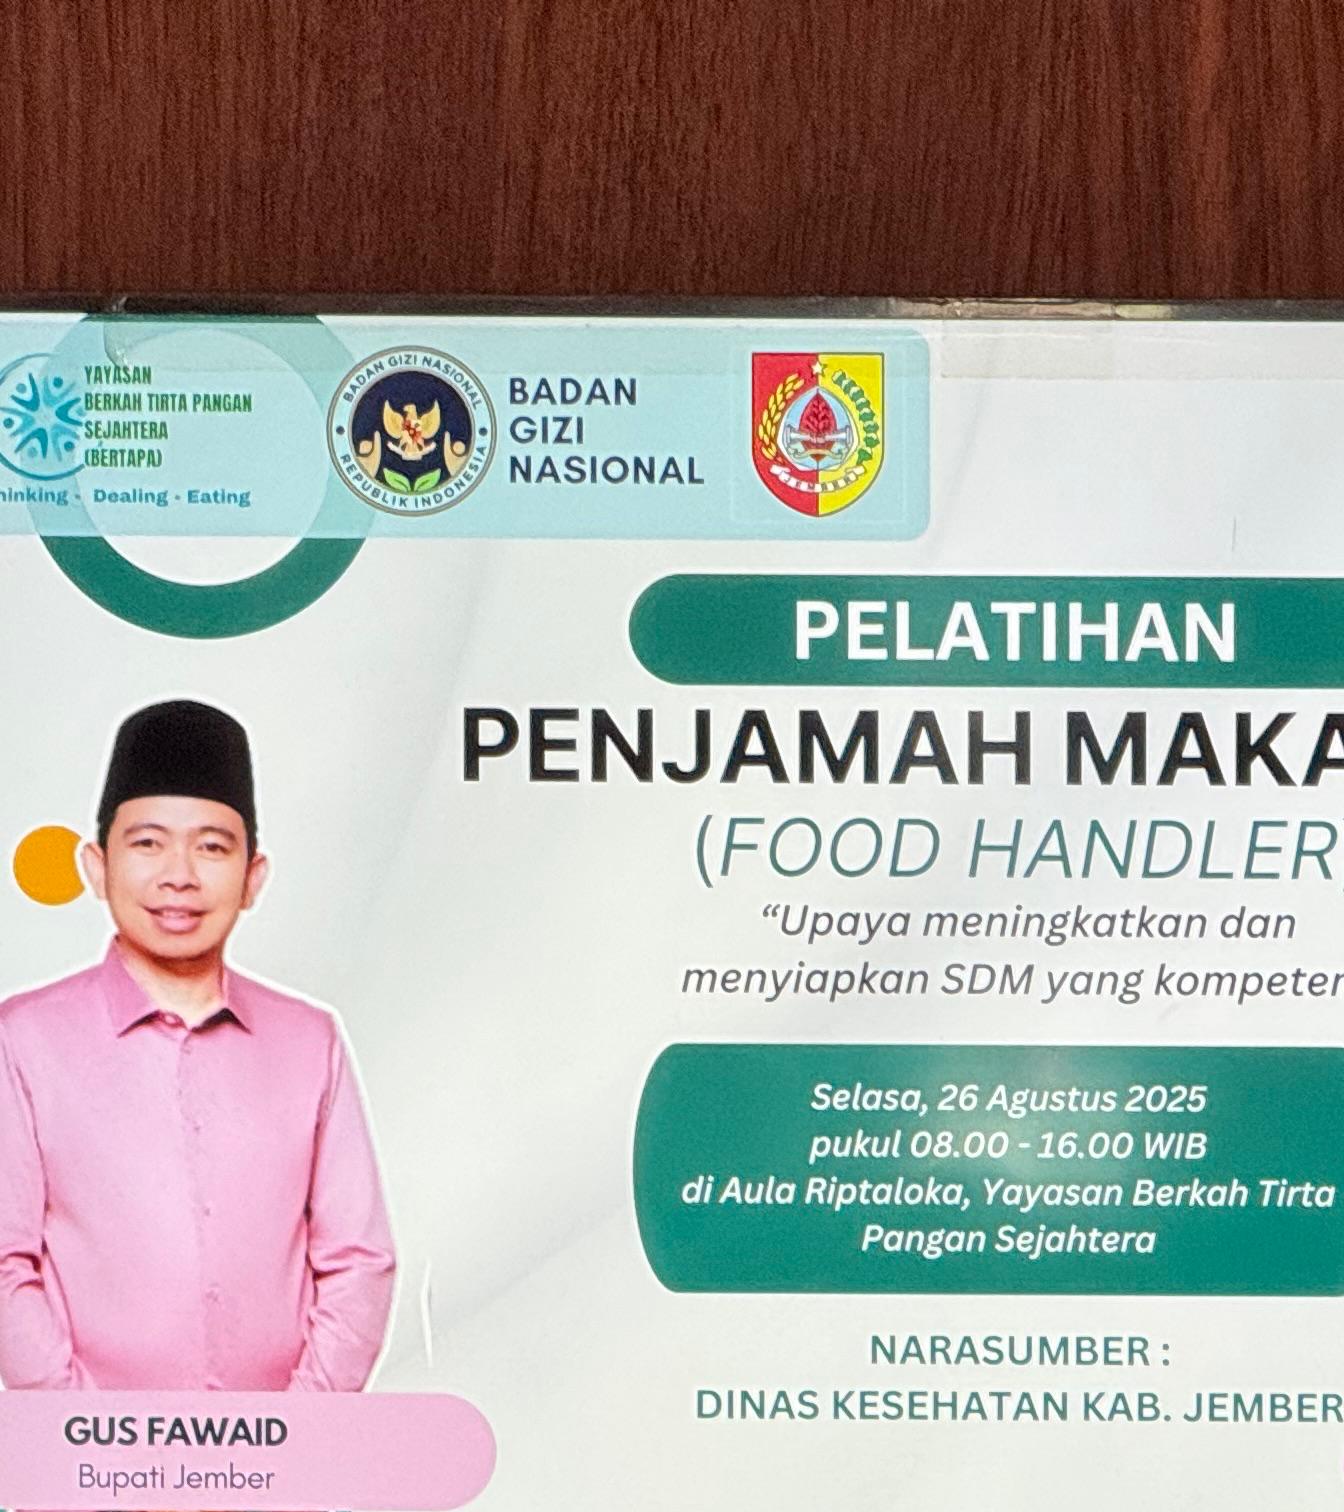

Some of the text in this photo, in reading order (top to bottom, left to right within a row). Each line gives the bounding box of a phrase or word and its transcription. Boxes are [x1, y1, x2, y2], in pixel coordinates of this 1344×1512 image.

[84, 365, 152, 385] YAYASAN
[343, 354, 482, 411] BADAN GIZI NASIONAL
[509, 377, 637, 406] BADAN
[84, 391, 253, 413] BERKAH TIRTA PANGAN
[84, 420, 169, 440] SEJAHTERA
[509, 415, 584, 445] GIZI
[84, 448, 163, 468] (BERTAPA)
[509, 455, 705, 485] NASIONAL
[340, 445, 487, 509] REPUBLIK INDONESIA
[93, 488, 169, 508] Dealing
[187, 488, 251, 508] Eating
[795, 600, 1235, 663] PELATIHAN
[463, 707, 1031, 785] PENJAMAH
[696, 814, 941, 889] (FOOD
[922, 904, 1207, 947] meningkatkan
[1220, 905, 1296, 939] dan
[681, 960, 929, 1003] menyiapkan
[940, 963, 1035, 995] SDM
[1040, 968, 1145, 1005] yang
[810, 1081, 1208, 1120] Selasa, 26 Agustus 2025
[808, 1128, 902, 1165] pukul
[910, 1130, 1010, 1159] 08.00
[1036, 1131, 1134, 1160] 16.00
[1144, 1131, 1208, 1160] WIB
[681, 1174, 1336, 1214] di Aula Riptaloka, Yayasan Berkah Tirta
[861, 1223, 1157, 1260] Pangan Sejahtera
[871, 1335, 1150, 1366] NARASUMBER
[697, 1389, 1344, 1423] DINAS KESEHATAN KAB. JEMBER
[64, 1416, 288, 1447] GUS FAWAID
[79, 1461, 276, 1497] Bupati Jember
